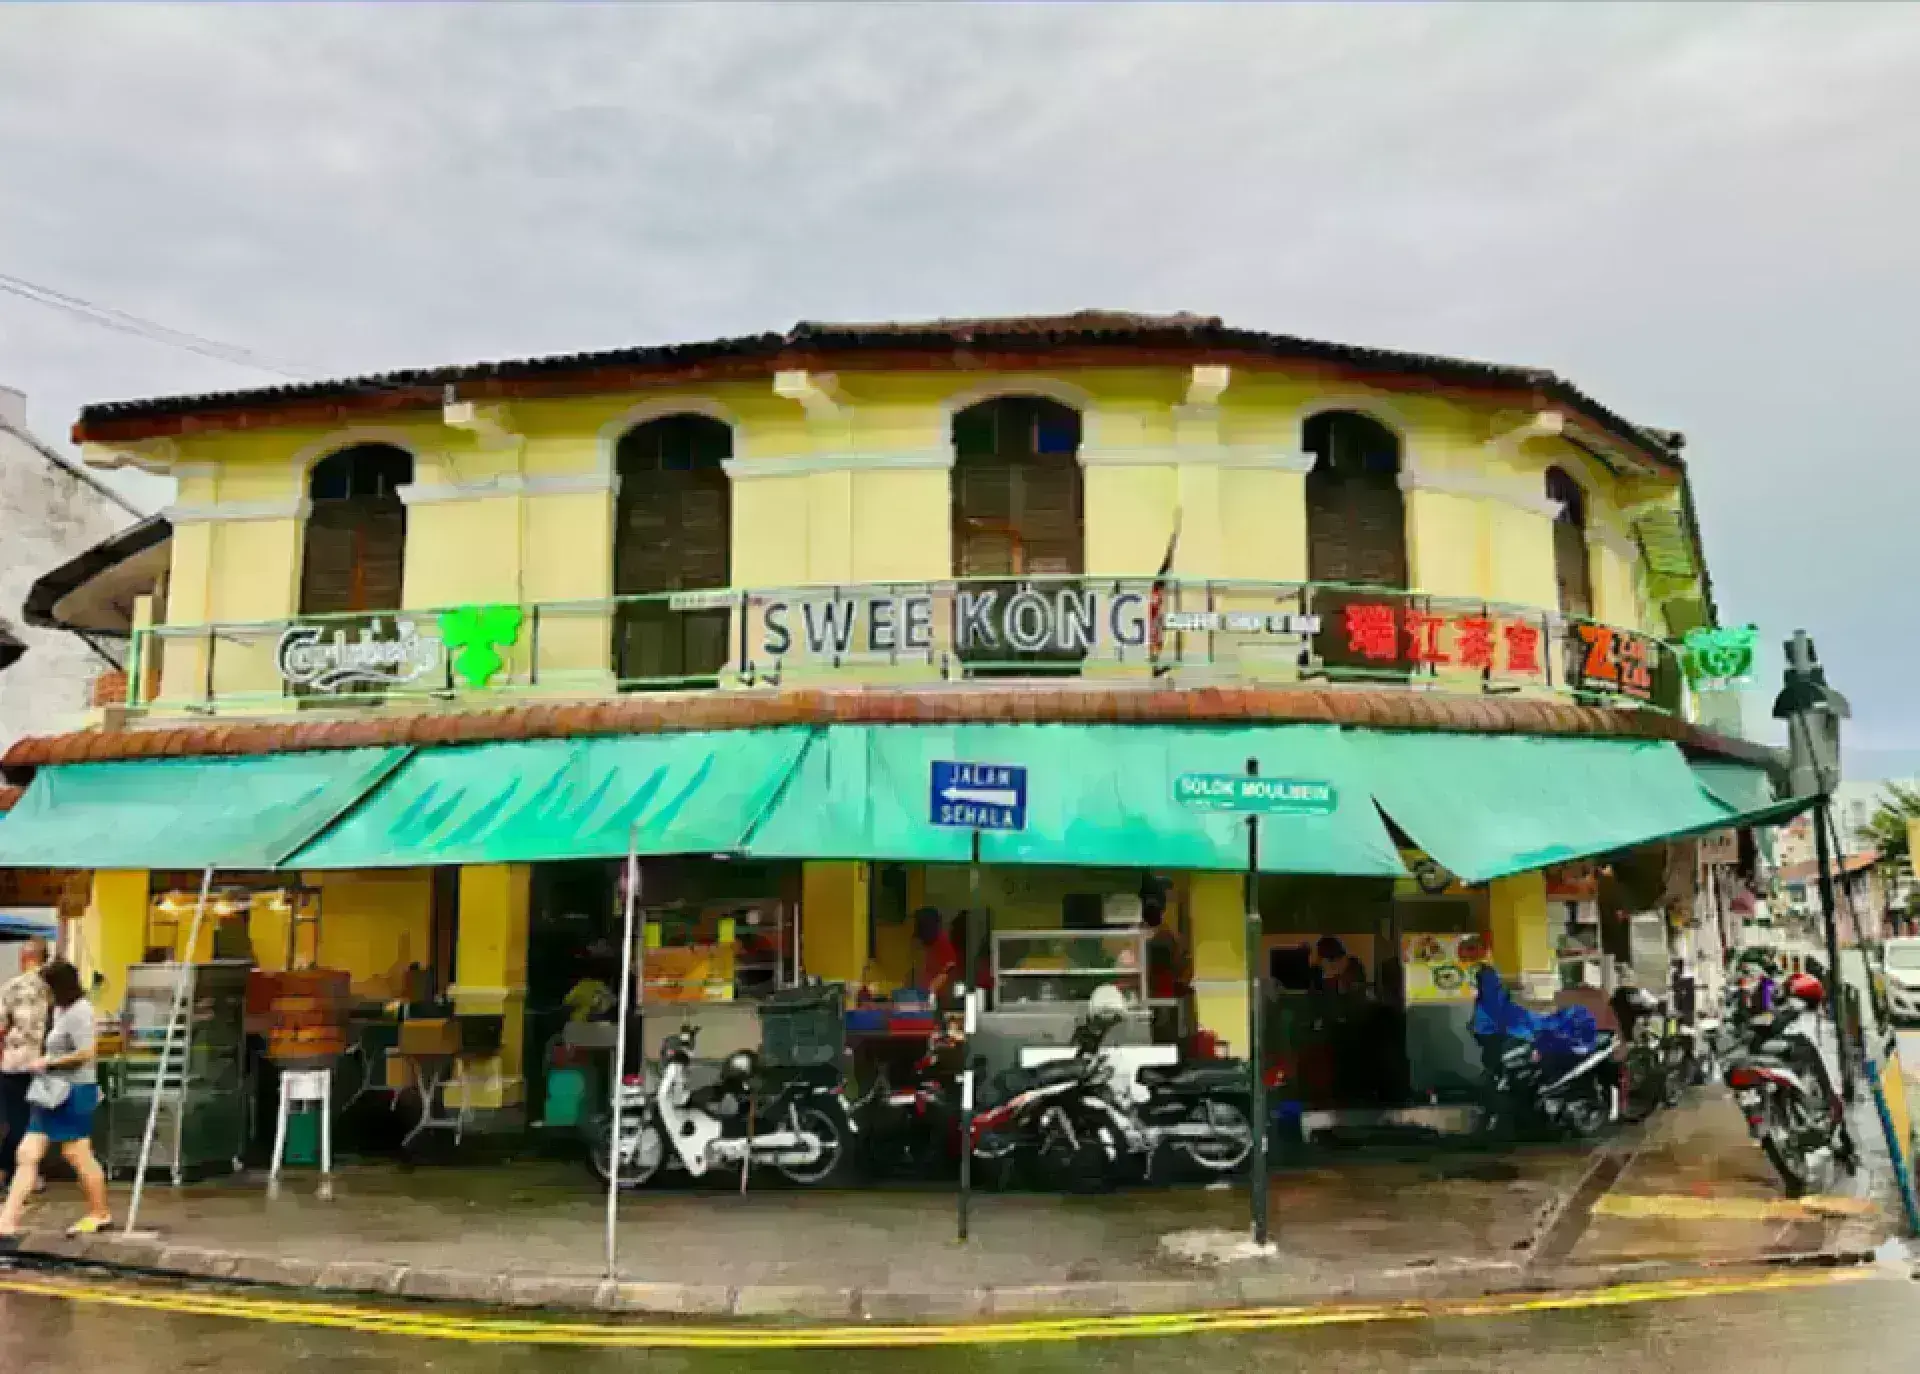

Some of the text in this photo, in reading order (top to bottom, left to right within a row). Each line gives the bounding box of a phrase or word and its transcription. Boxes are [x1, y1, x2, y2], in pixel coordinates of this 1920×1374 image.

[762, 587, 1147, 654] SWEE KONG
[949, 763, 1009, 785] JALAN
